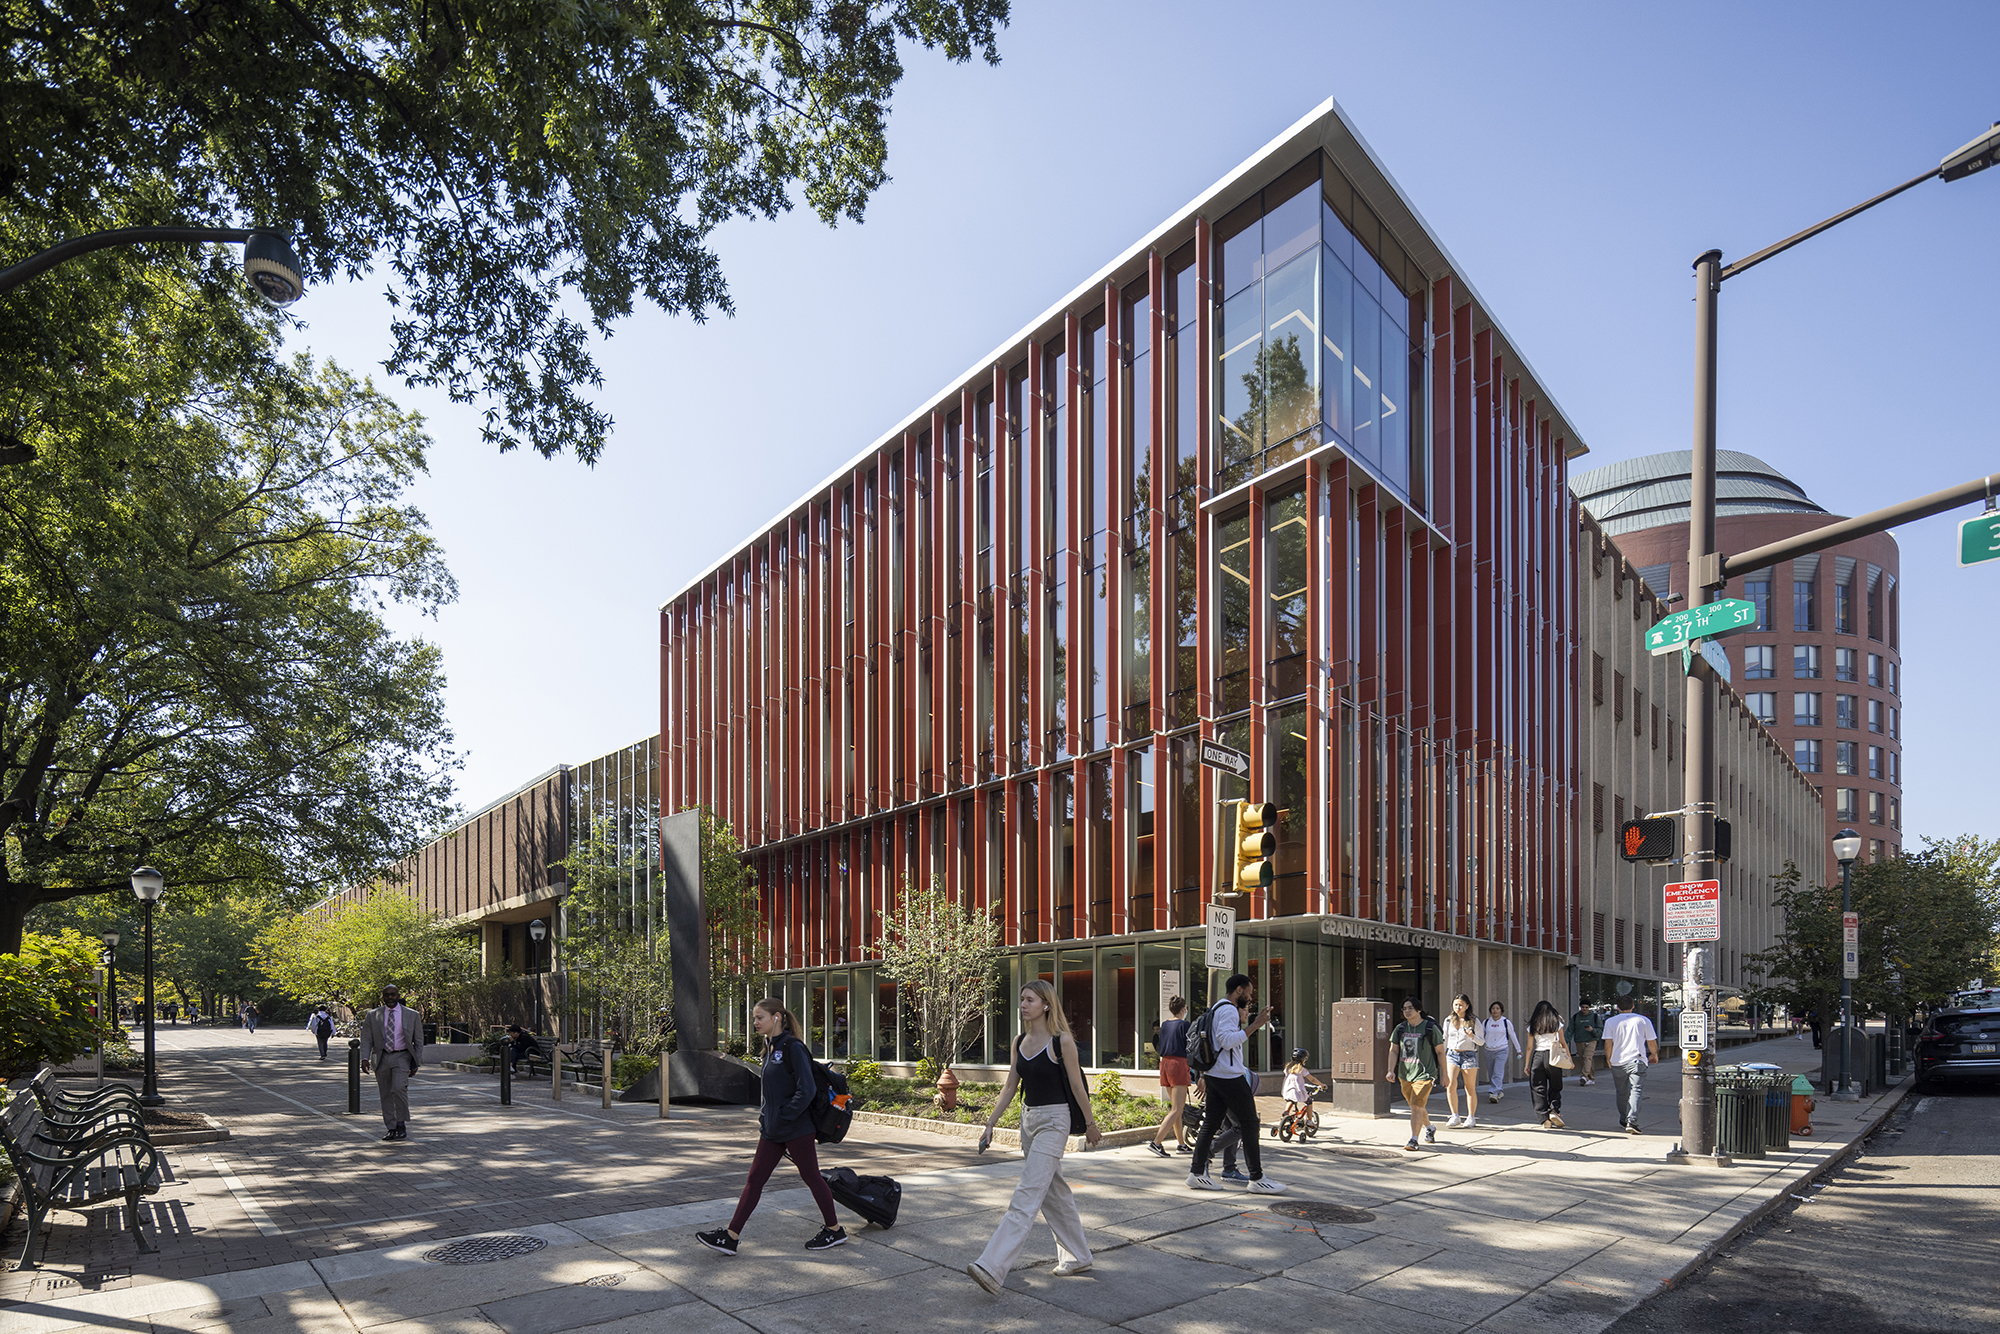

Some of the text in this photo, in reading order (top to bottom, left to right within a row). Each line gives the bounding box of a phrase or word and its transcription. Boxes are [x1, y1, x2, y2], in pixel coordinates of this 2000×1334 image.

[1675, 604, 1722, 622] 200 S 100
[1672, 621, 1692, 642] 37
[1734, 608, 1749, 623] ST
[1206, 749, 1238, 767] ONE WAY
[1666, 887, 1717, 896] EMERGENCY
[1215, 911, 1228, 924] NO
[1213, 926, 1230, 938] TURN
[1320, 920, 1467, 953] GRADUATE SCHOOL OF EDUCATION
[1216, 940, 1225, 950] ON
[1213, 953, 1226, 964] RED
